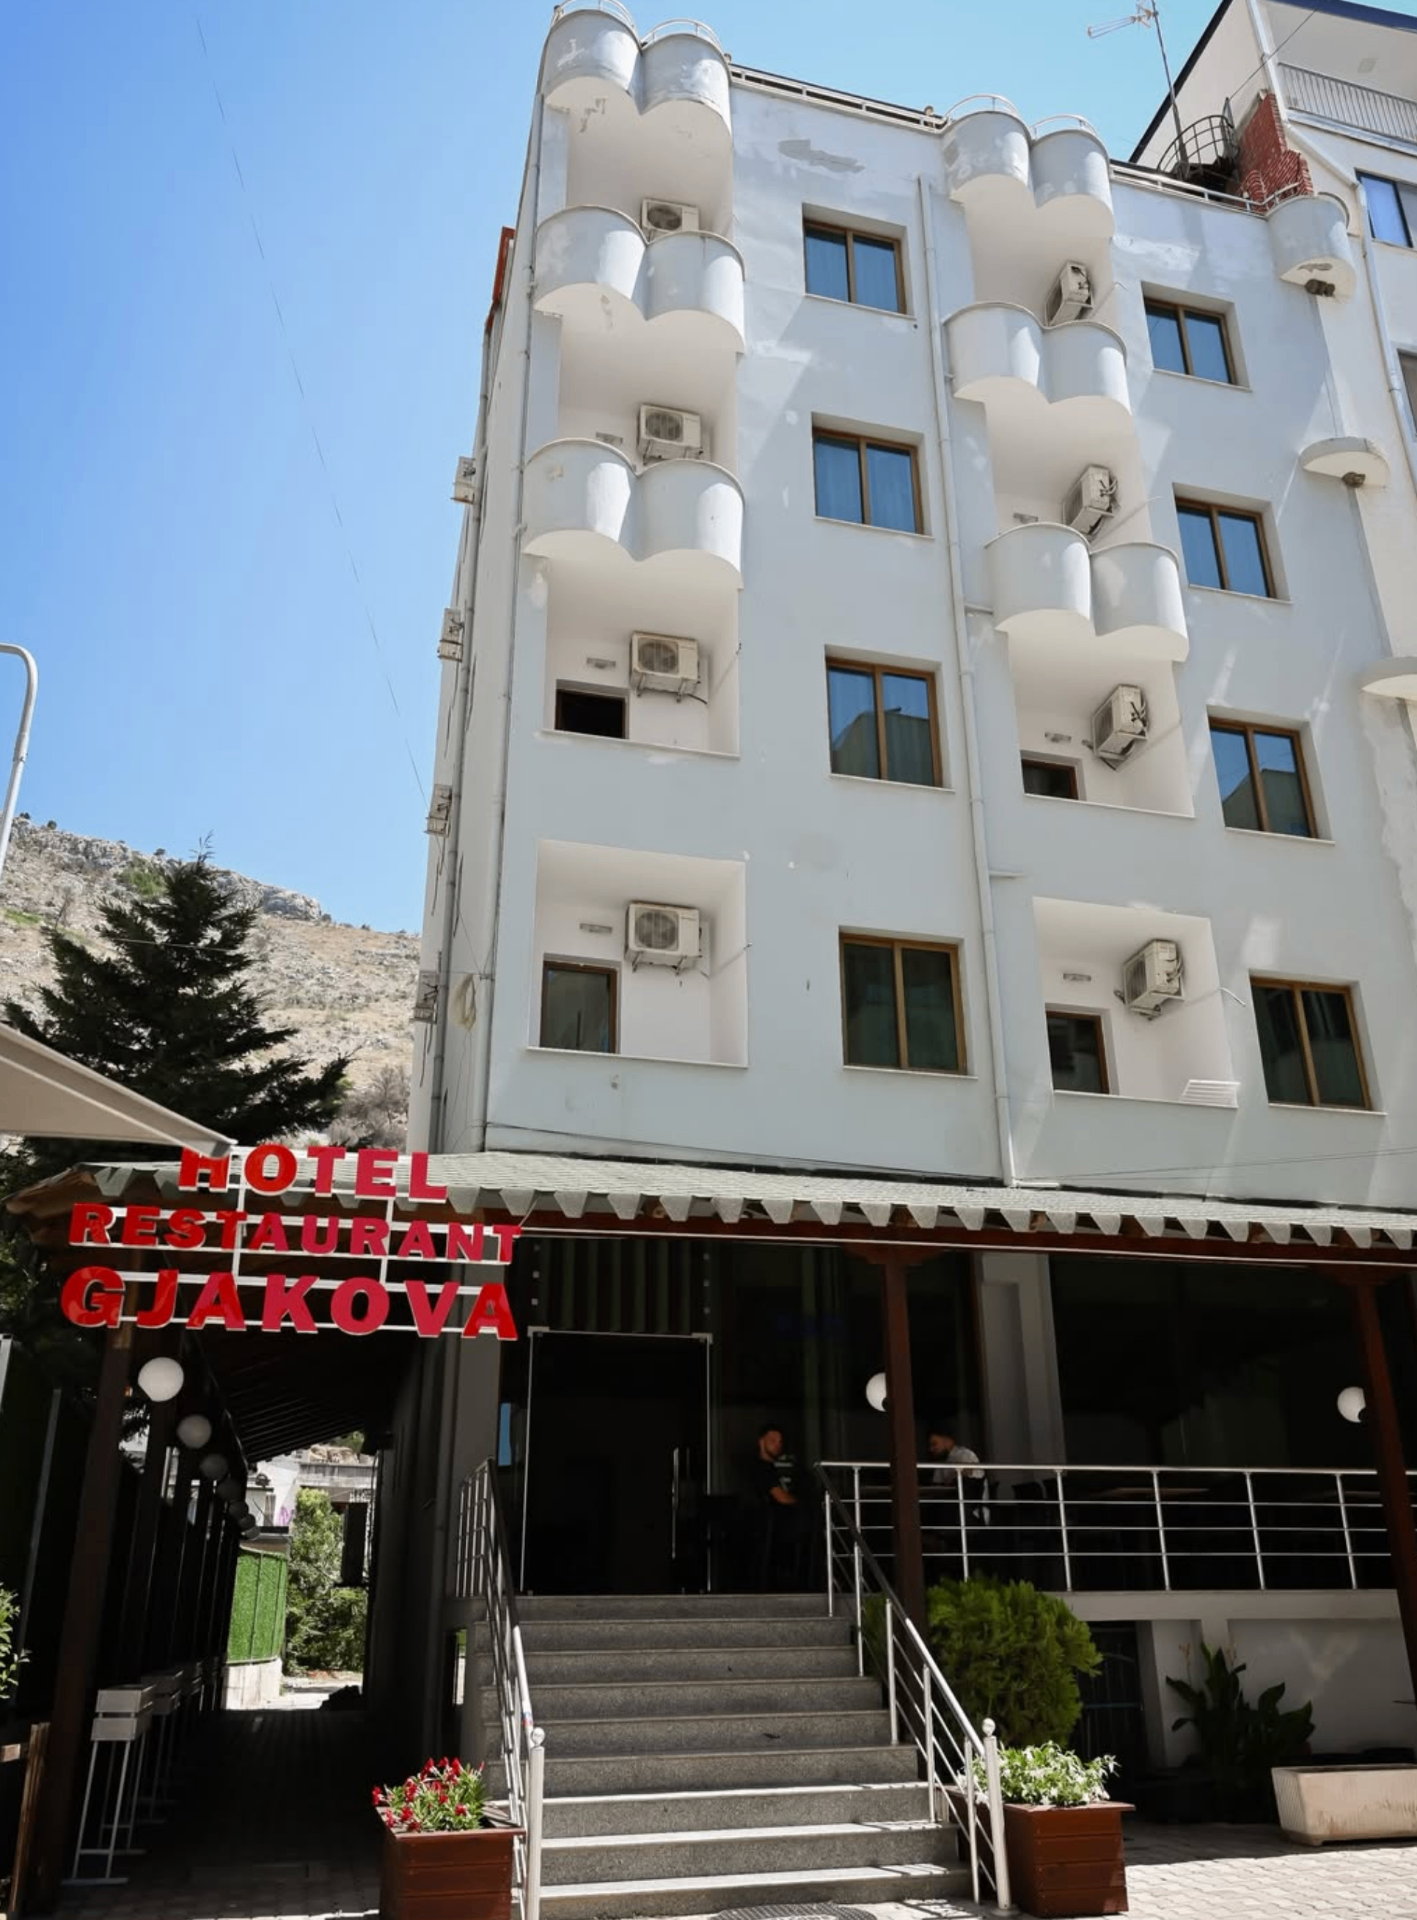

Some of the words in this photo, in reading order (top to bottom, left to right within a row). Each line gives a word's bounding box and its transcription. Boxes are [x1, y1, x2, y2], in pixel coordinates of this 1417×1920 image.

[178, 1145, 447, 1203] HOTEL
[69, 1203, 522, 1265] RESTAURANT
[60, 1266, 518, 1341] GJAKOVA
